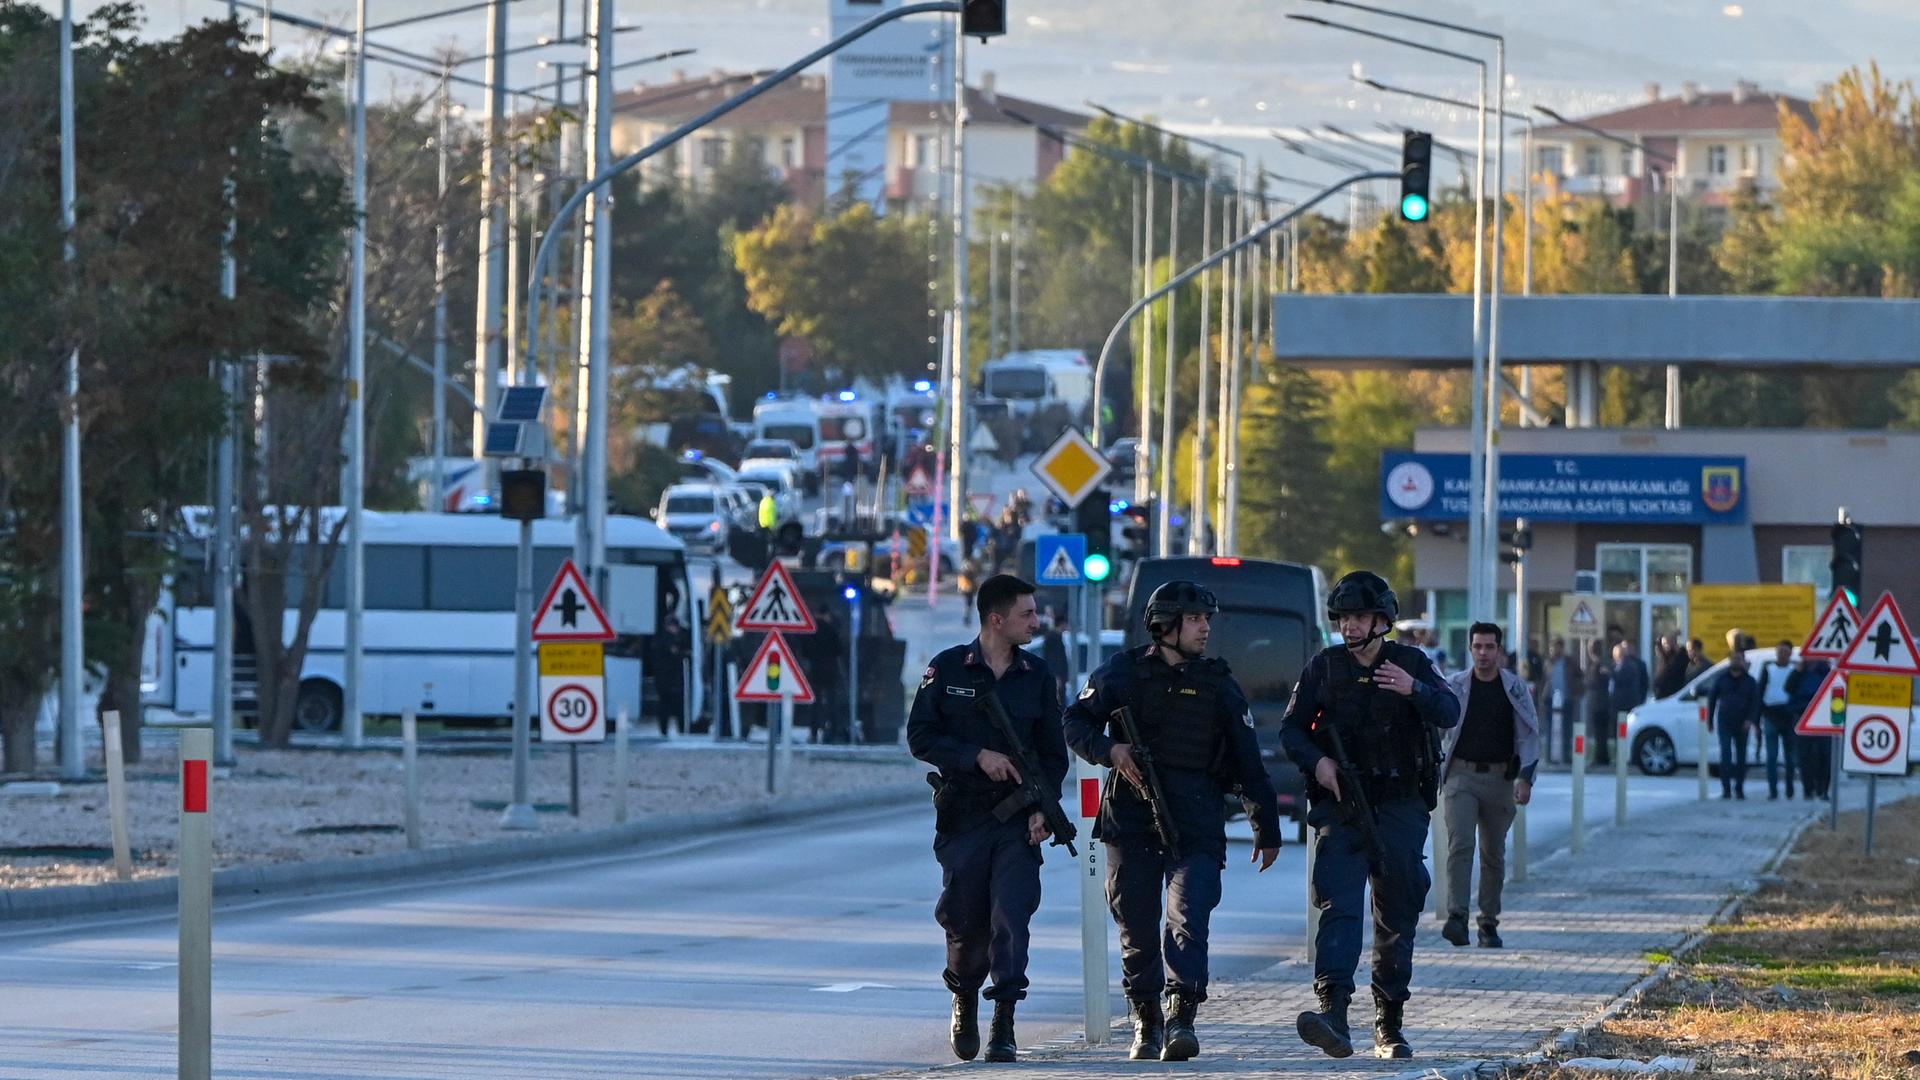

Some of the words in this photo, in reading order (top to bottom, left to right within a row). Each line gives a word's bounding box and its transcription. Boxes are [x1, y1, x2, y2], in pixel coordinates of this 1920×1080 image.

[1579, 478, 1690, 494] KAYMAKAMLIĞI
[1495, 497, 1573, 512] ANDARMA
[1575, 496, 1626, 514] ASAYİŞ
[1629, 499, 1692, 514] NOKTASI
[558, 698, 586, 718] 30
[1862, 728, 1890, 749] 30
